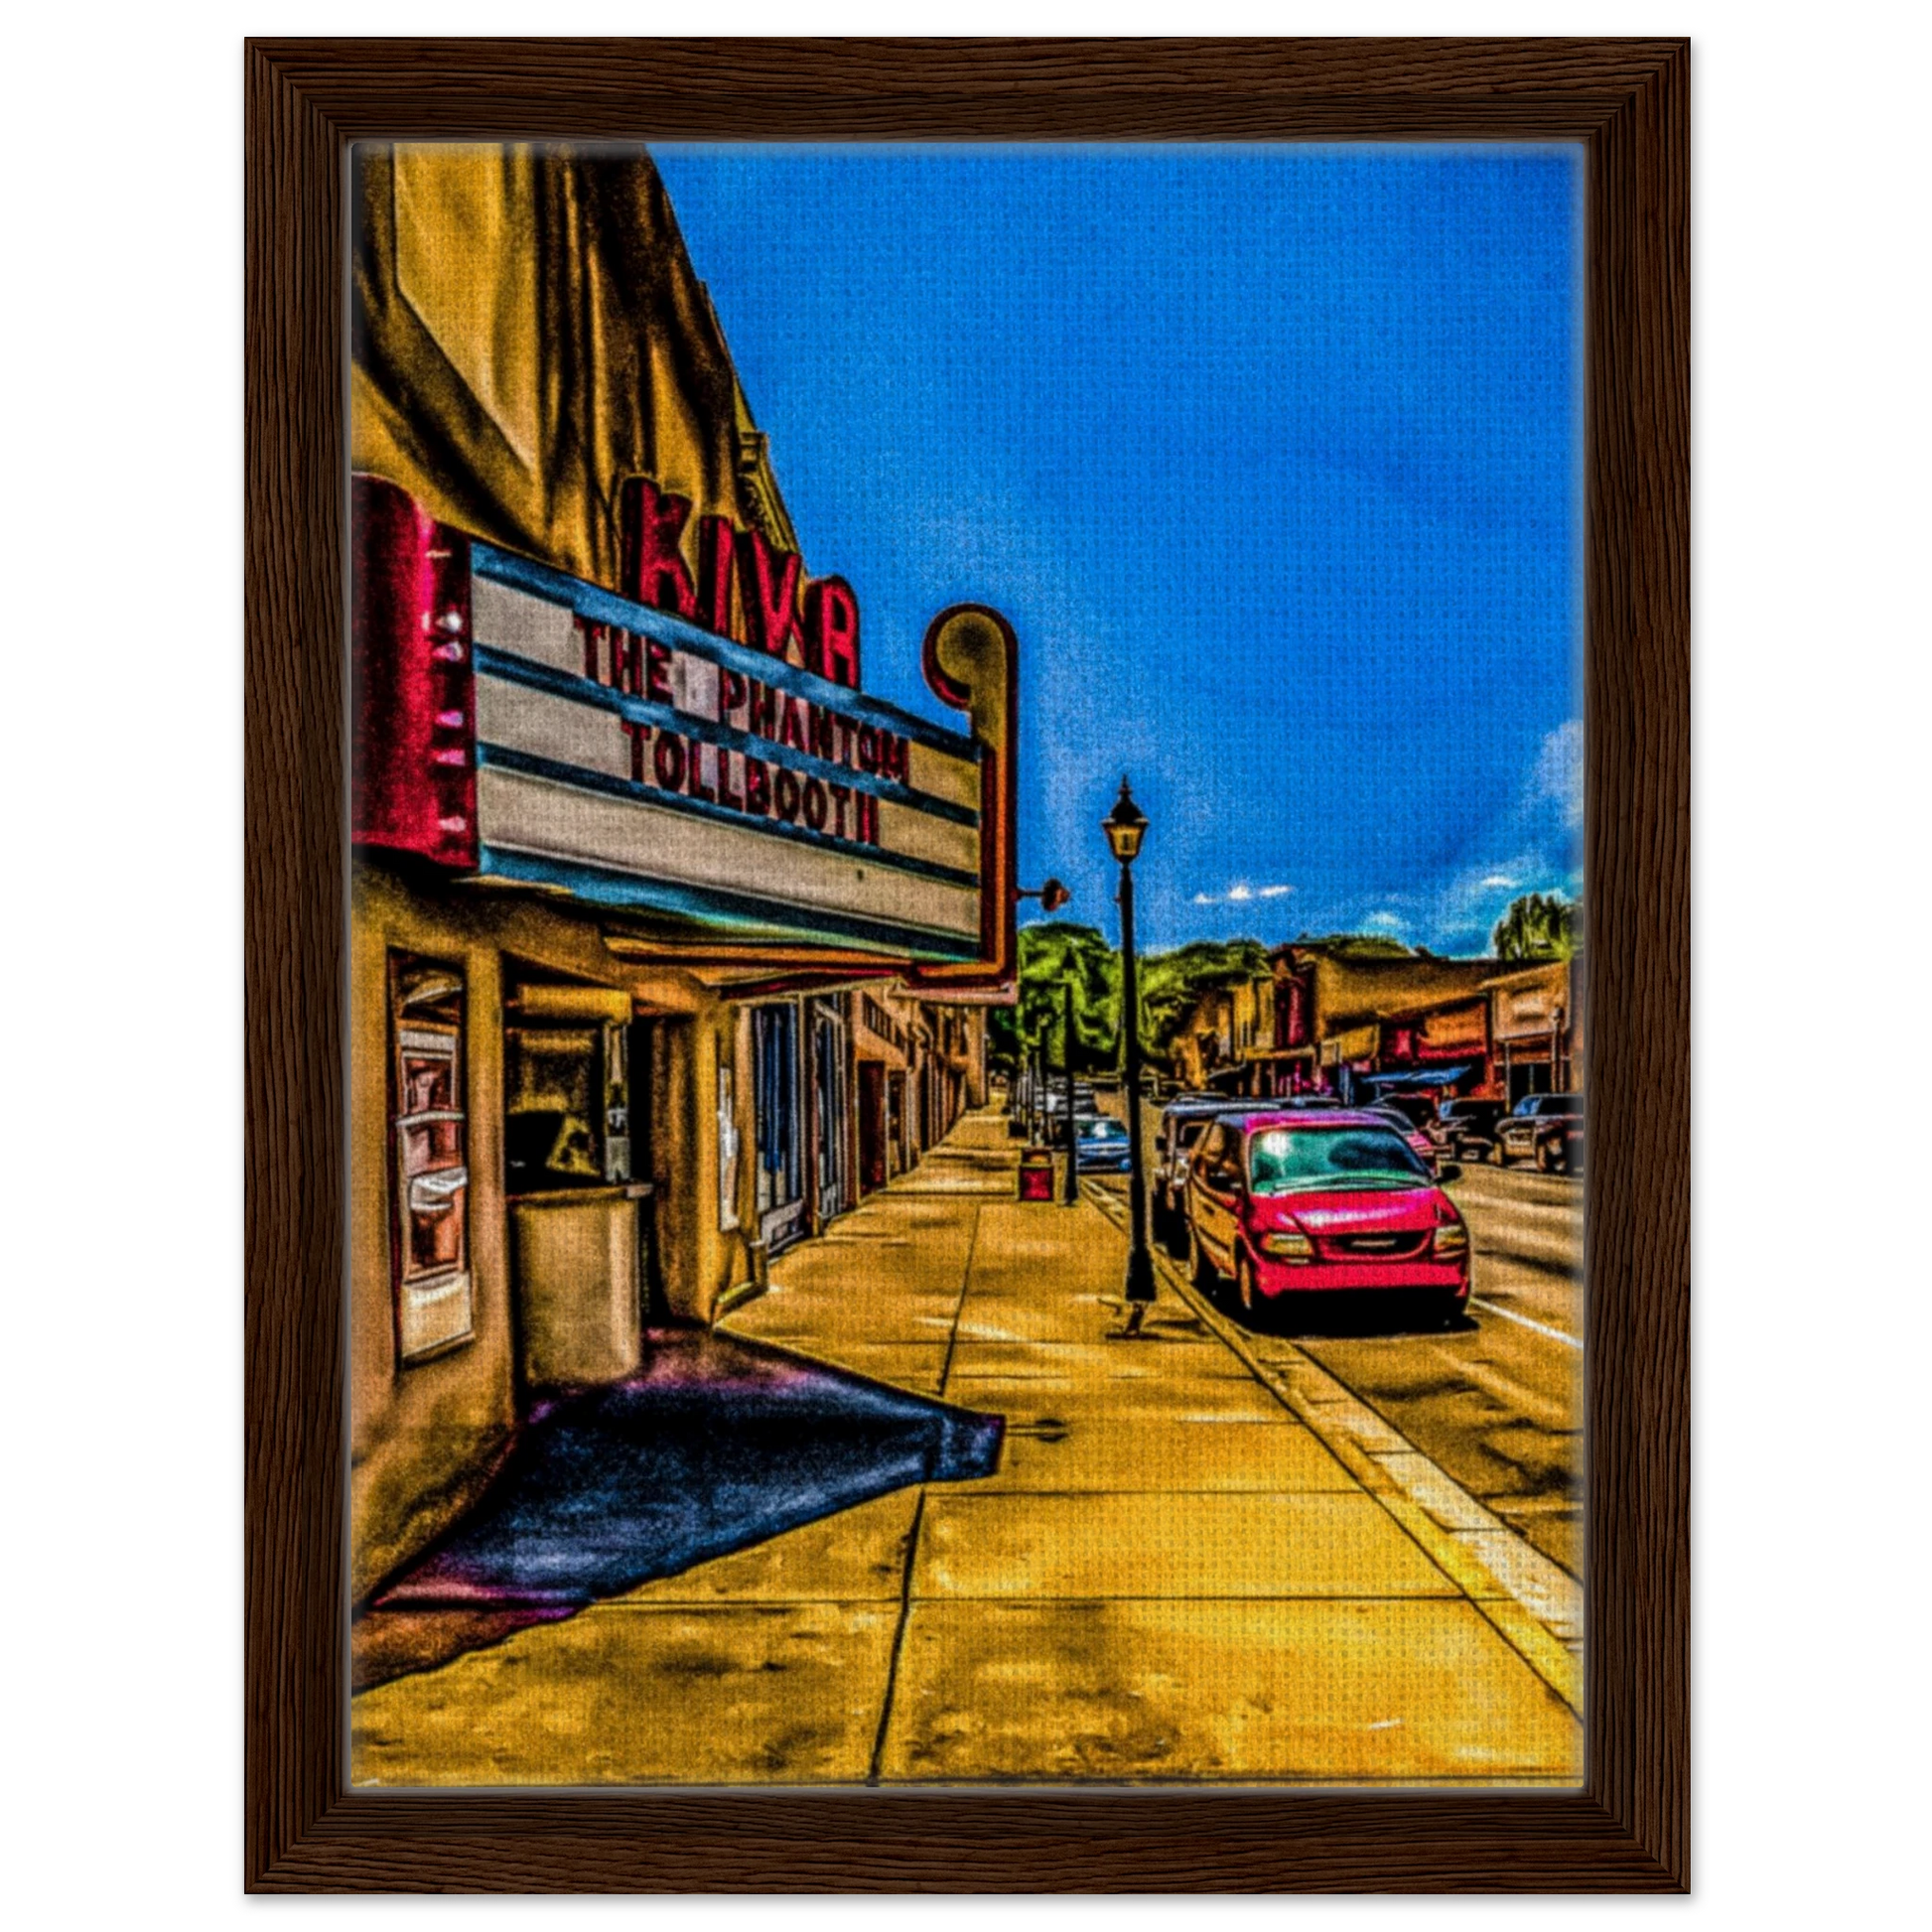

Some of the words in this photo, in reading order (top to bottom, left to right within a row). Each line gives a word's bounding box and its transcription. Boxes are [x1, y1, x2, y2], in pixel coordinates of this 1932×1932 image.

[621, 477, 860, 692] KIVA
[574, 615, 673, 703] THE
[721, 664, 910, 785] PHANTOM
[621, 719, 880, 845] TOLLBOOTH
